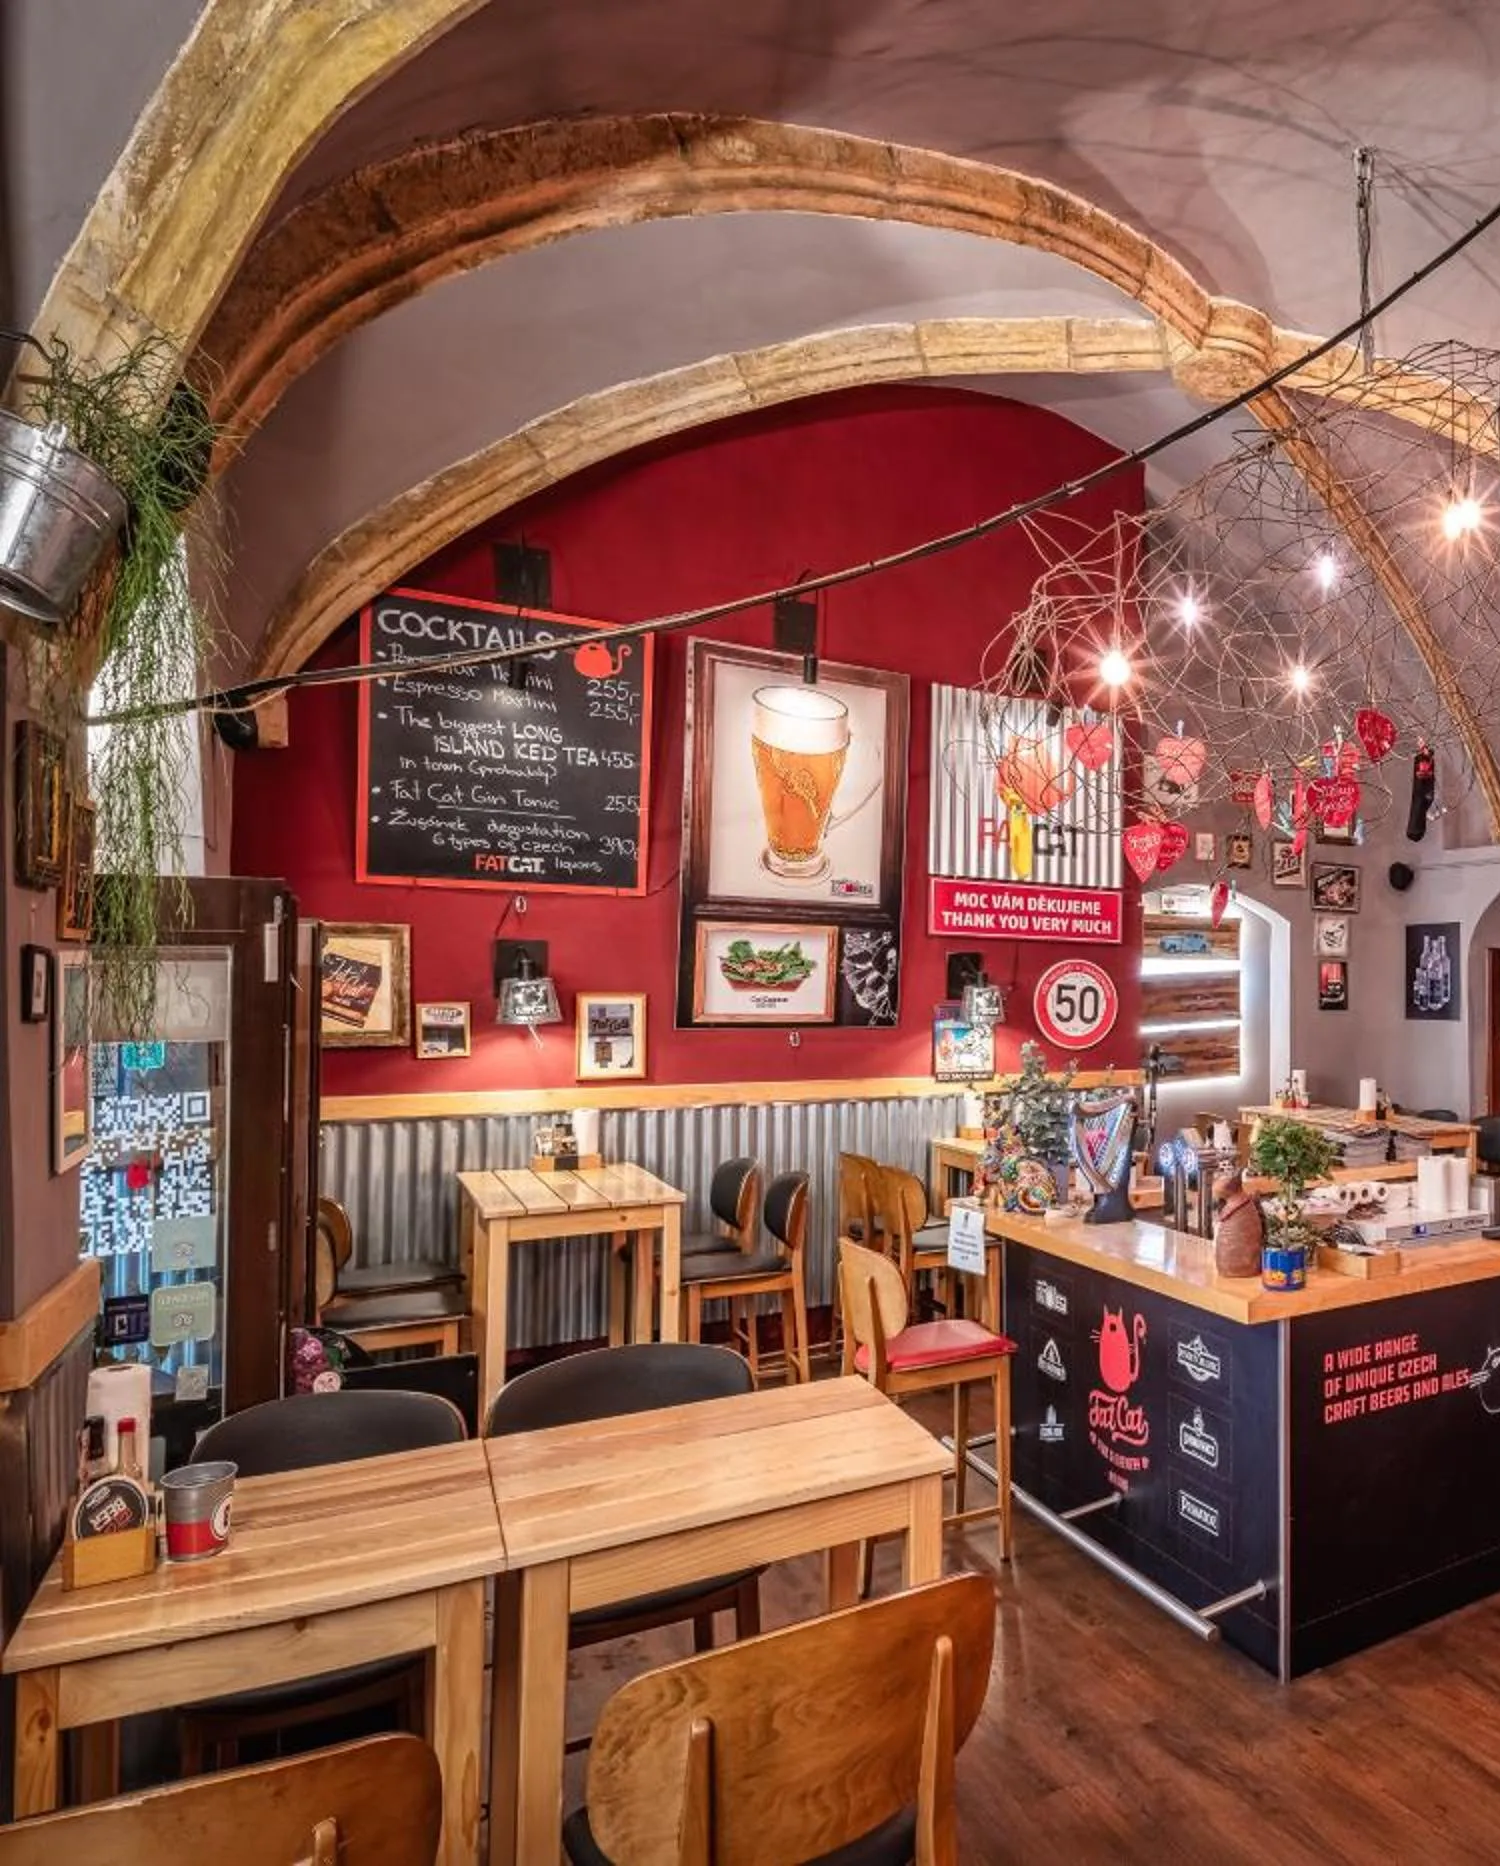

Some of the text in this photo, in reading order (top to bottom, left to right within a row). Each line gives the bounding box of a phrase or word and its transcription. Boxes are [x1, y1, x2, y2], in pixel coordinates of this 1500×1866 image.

[378, 609, 556, 660] COCKTAILS
[393, 672, 484, 701] Espresso
[493, 687, 557, 713] Martini
[393, 705, 563, 744] The biggest LONG
[400, 755, 417, 769] in
[423, 755, 463, 773] town
[433, 735, 505, 759] ISLAND
[513, 742, 557, 762] ICED
[562, 747, 599, 767] TEA
[390, 779, 421, 801] Fat
[427, 783, 464, 804] Cat
[471, 784, 507, 805] Gin
[512, 789, 561, 811] Tonic
[954, 891, 1102, 915] MOC VÁM DĚKUJEME
[942, 911, 1112, 935] THANK YOU VERY MUCH
[1055, 984, 1099, 1024] 50
[1324, 1333, 1419, 1373] A WIDE RANGE
[1324, 1353, 1438, 1399] OF UNIQUE CZECH
[1325, 1368, 1472, 1425] CRAFT BEERS AND ALES
